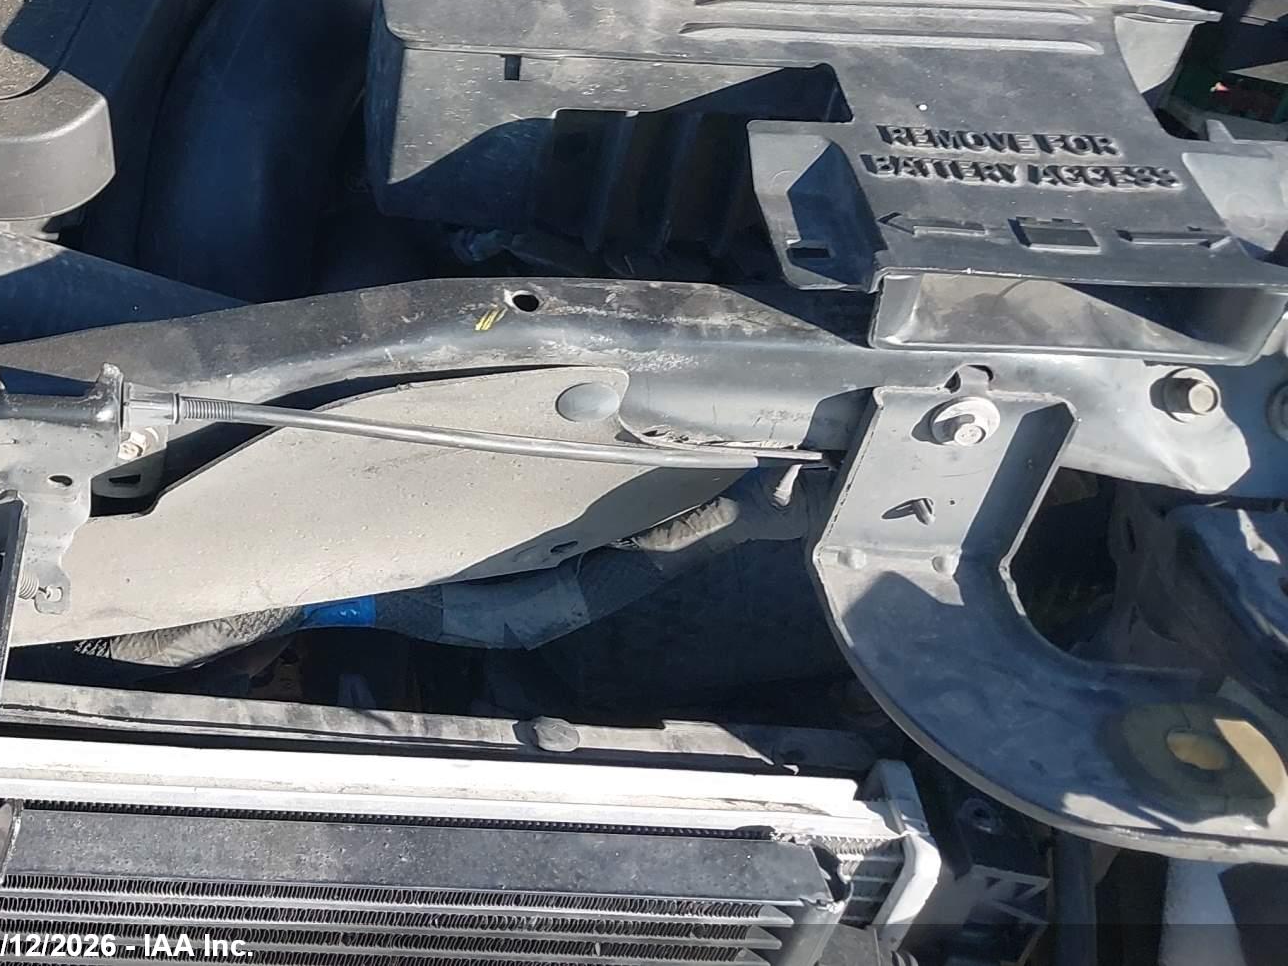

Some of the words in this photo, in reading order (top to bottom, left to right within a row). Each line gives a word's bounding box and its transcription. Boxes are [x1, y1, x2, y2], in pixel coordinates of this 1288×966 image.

[876, 125, 1037, 156] REMOVE
[1033, 132, 1122, 158] FOR
[859, 154, 1018, 187] BATTERY
[1027, 164, 1184, 190] ACCESS
